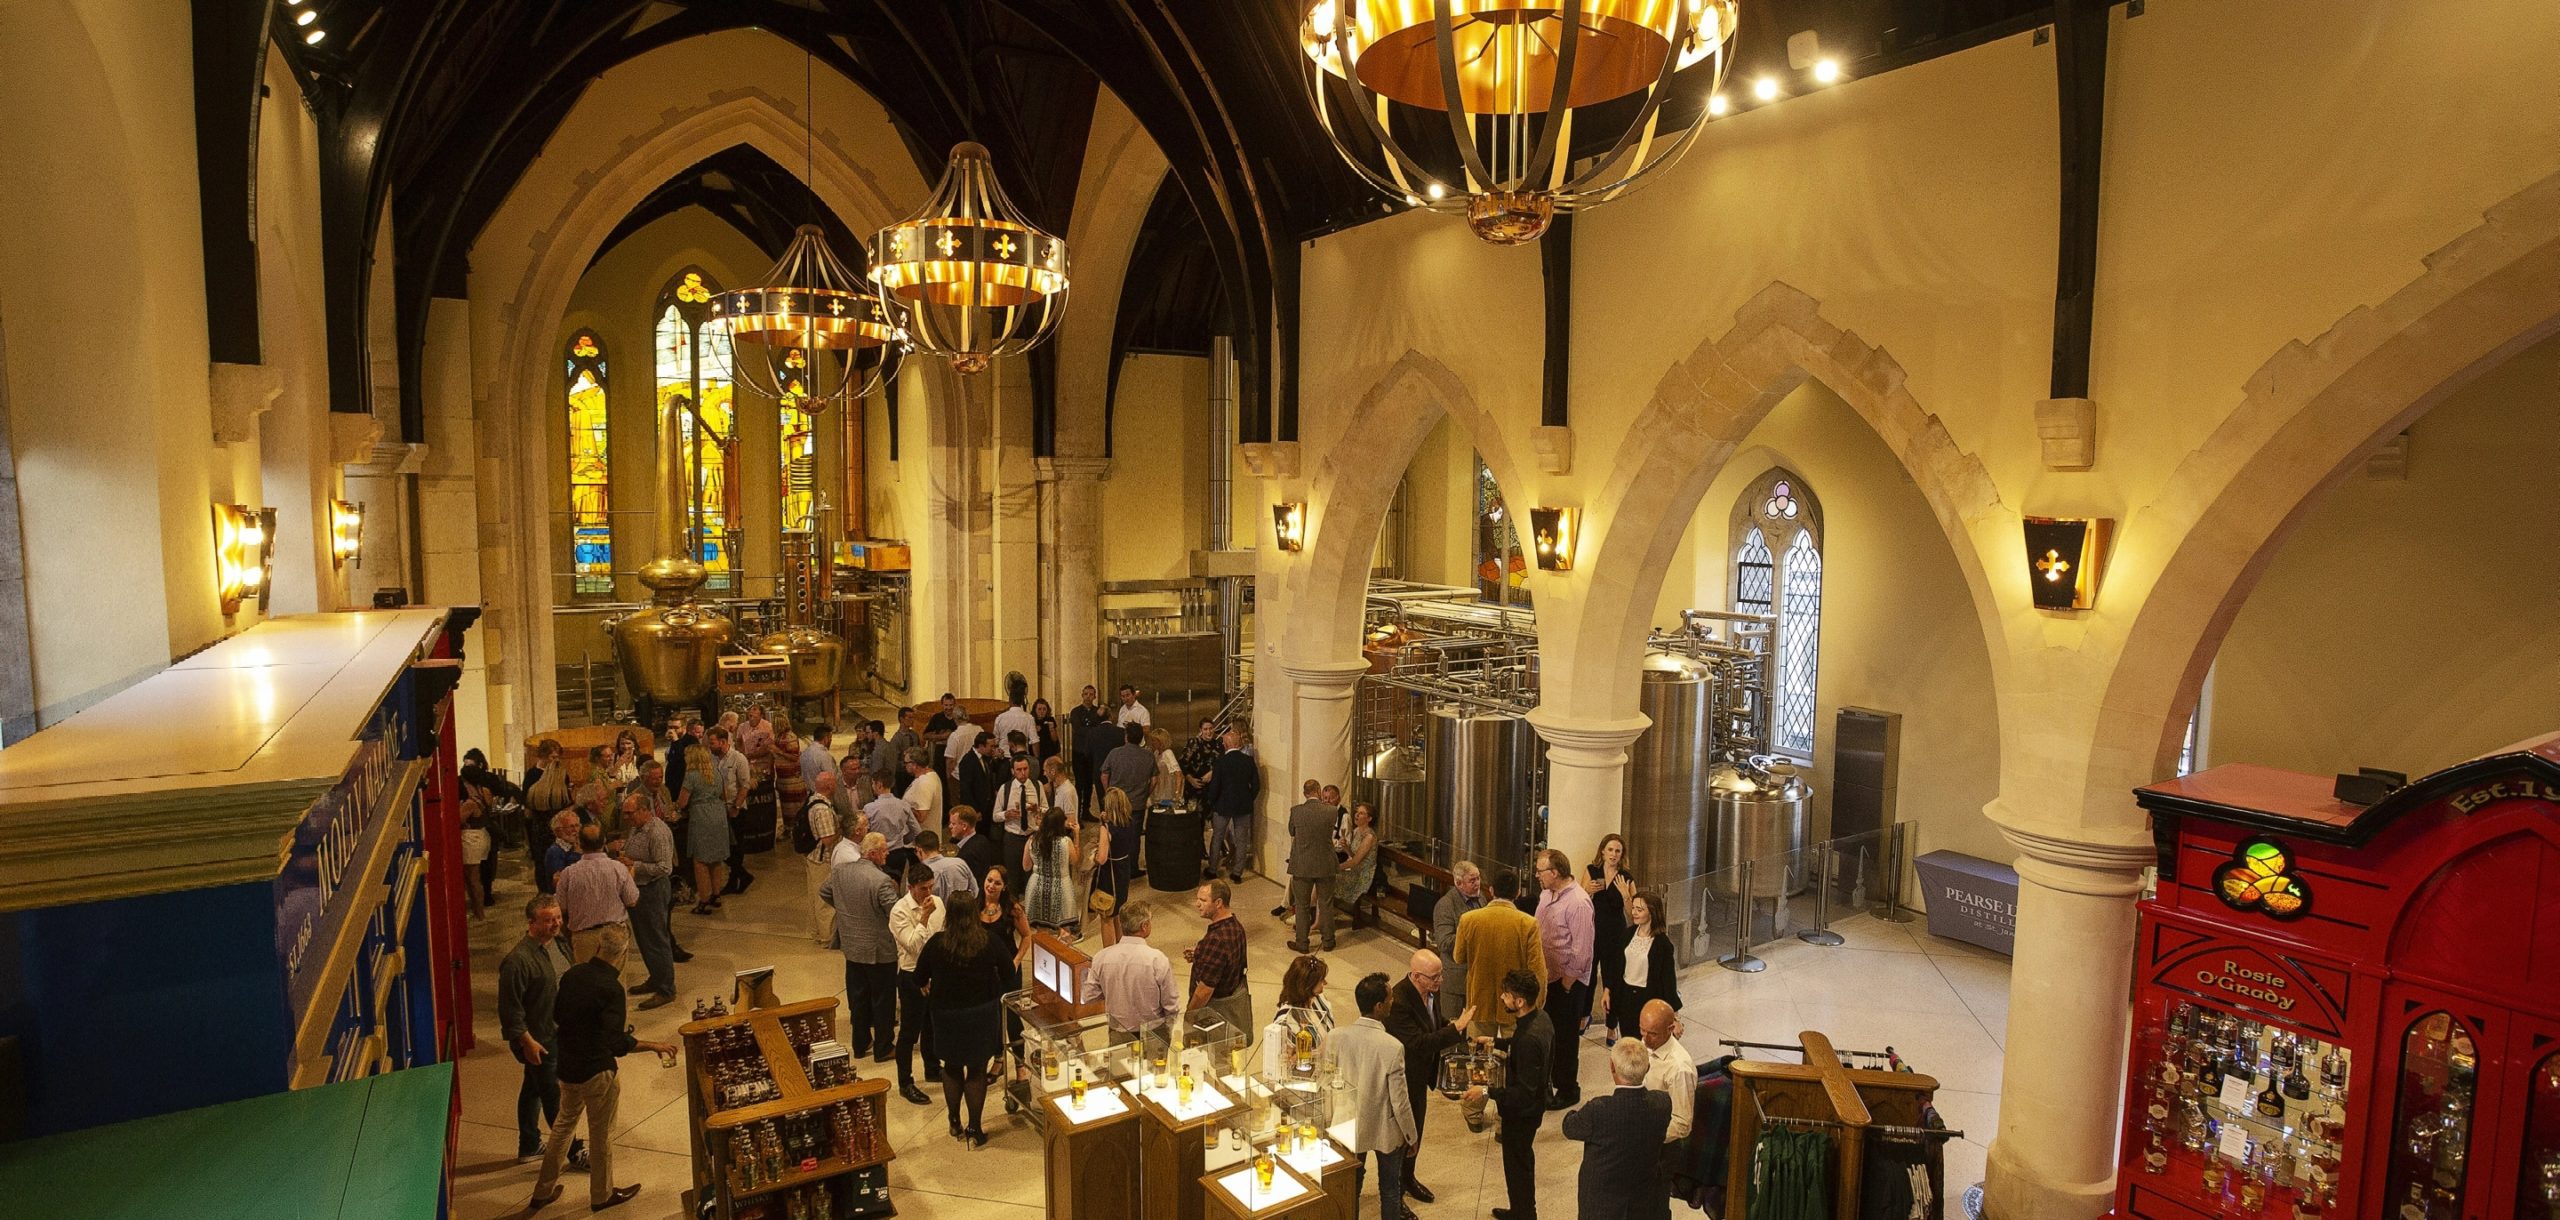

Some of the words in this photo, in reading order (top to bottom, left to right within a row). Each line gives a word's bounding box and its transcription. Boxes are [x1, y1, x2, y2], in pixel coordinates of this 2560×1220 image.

[317, 774, 363, 917] MOLLY
[364, 710, 400, 818] MALONE
[1945, 886, 2004, 914] PEARSE
[2196, 970, 2295, 1010] O'Grady
[2224, 960, 2286, 988] Rosie
